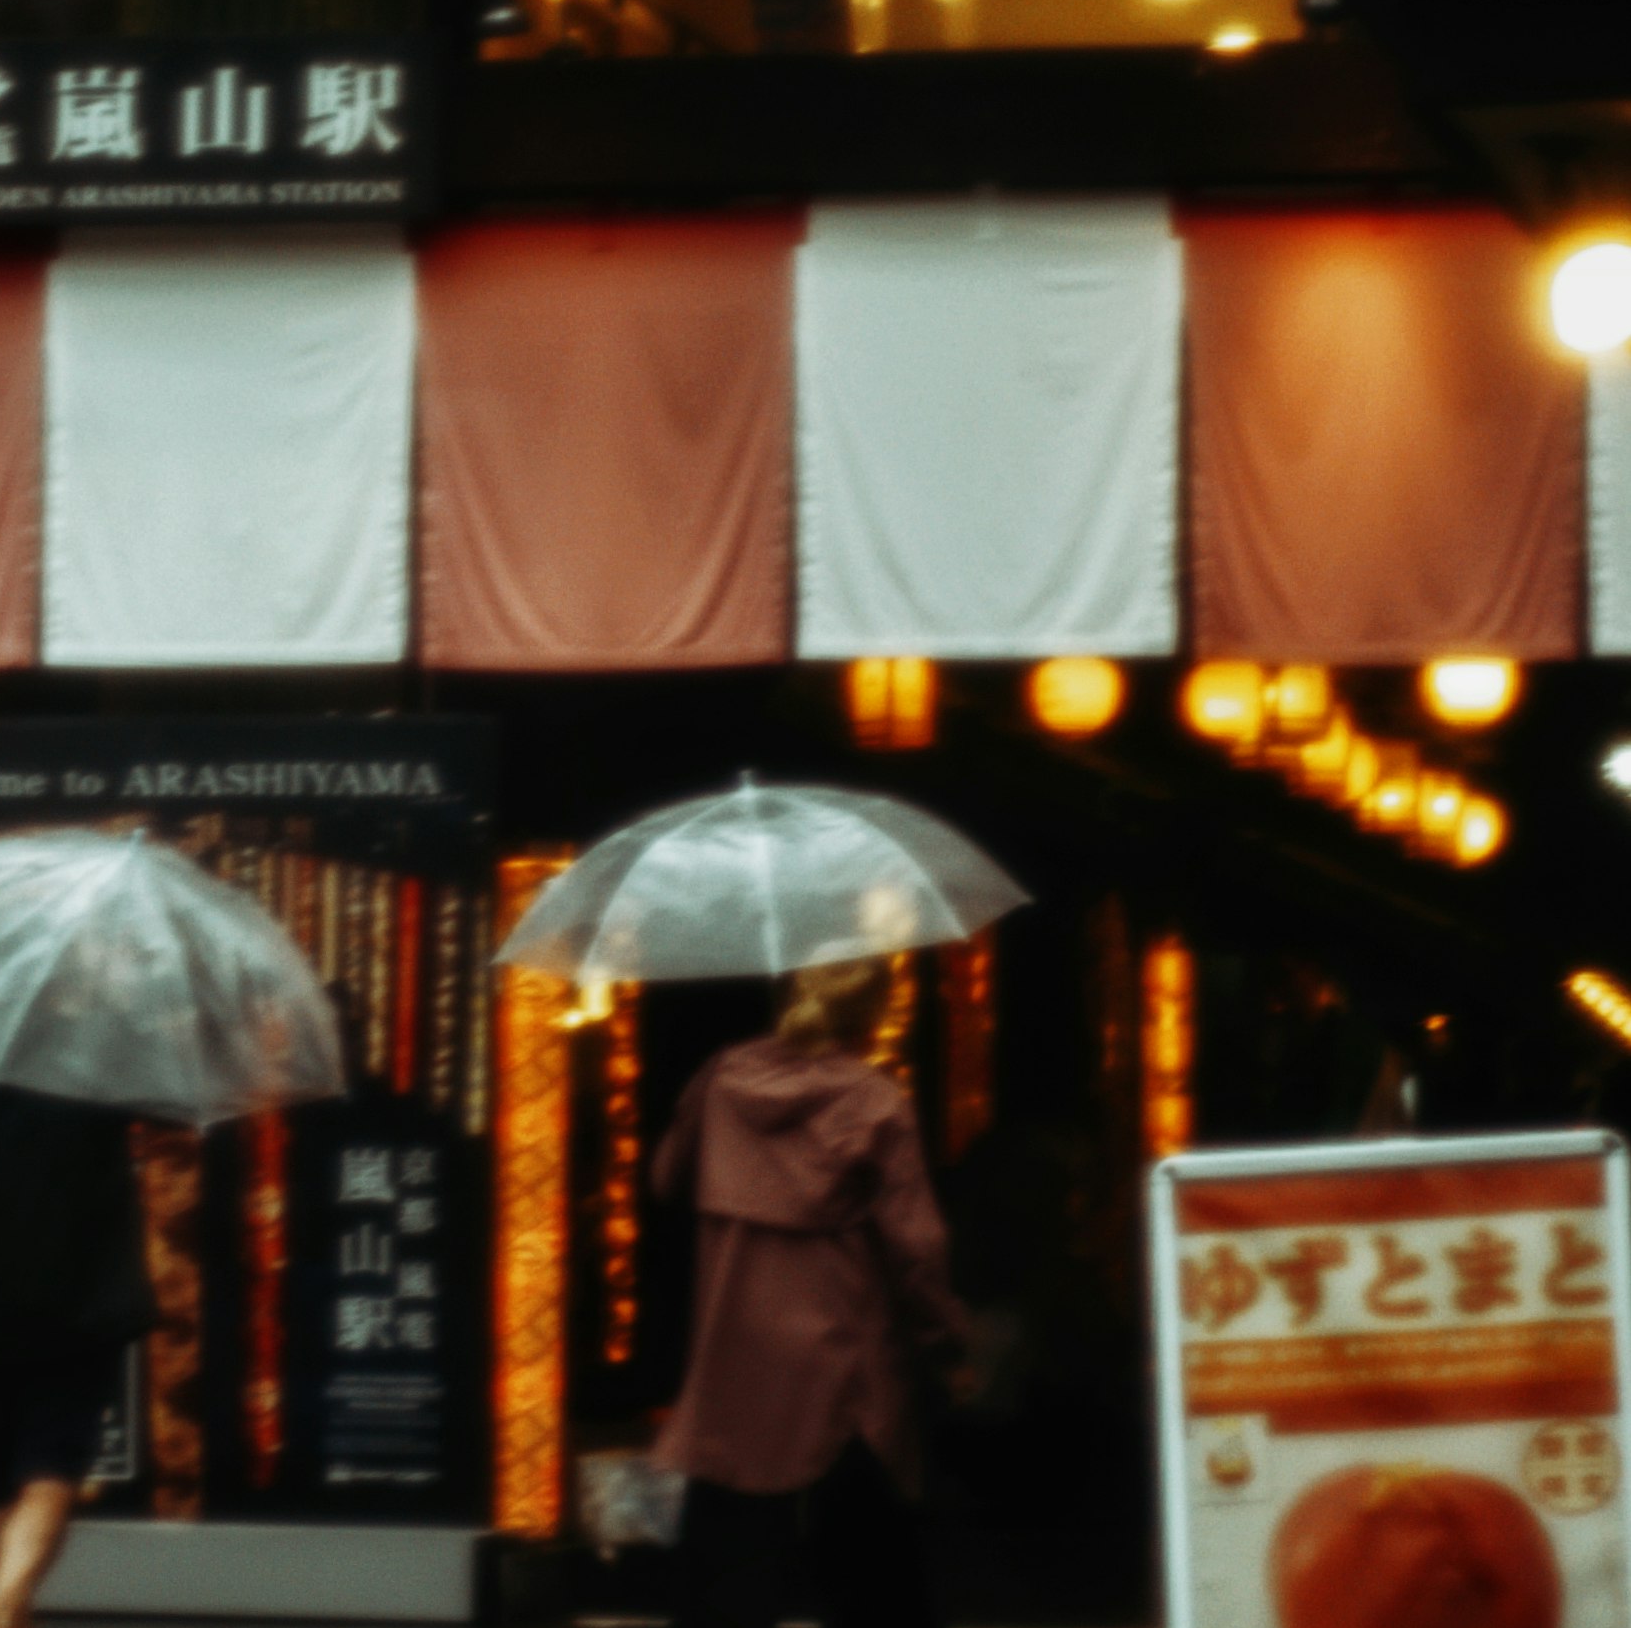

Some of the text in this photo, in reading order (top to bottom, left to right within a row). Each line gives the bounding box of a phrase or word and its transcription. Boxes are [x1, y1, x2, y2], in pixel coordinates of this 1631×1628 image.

[50, 62, 402, 160] 嵐山駅
[269, 181, 403, 205] STATION
[62, 767, 106, 796] to
[121, 762, 444, 796] ARASHIYAMA
[336, 1148, 395, 1350] 嵐山駅
[1178, 1223, 1609, 1333] ゆずとまと
